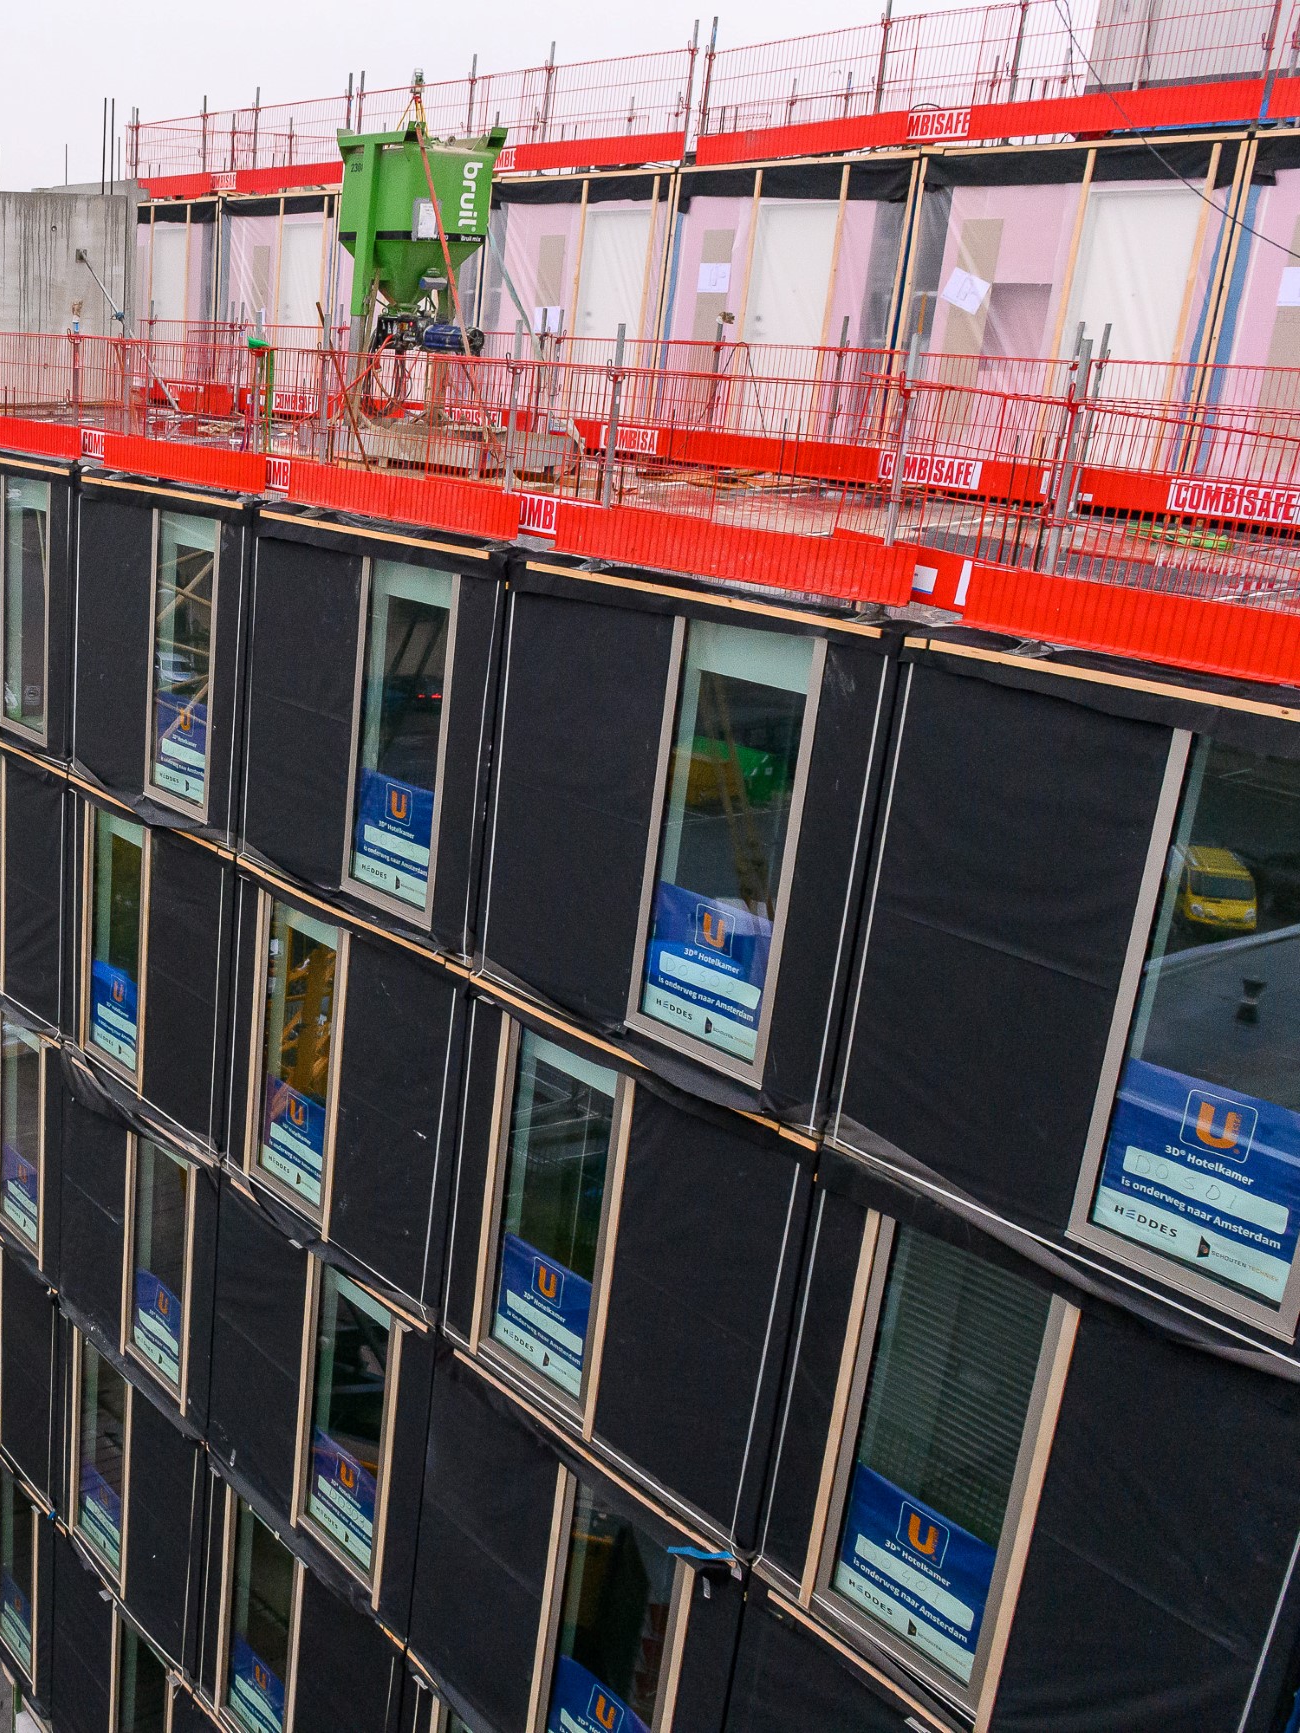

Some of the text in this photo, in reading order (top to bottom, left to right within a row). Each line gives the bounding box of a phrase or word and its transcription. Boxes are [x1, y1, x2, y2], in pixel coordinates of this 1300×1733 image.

[882, 453, 973, 487] CMBISAFE
[1174, 482, 1297, 521] COMBISAFE
[703, 912, 725, 948] U
[698, 950, 740, 975] Hotelkamer
[656, 998, 693, 1021] HEDDES
[665, 979, 698, 1000] onderweg
[698, 991, 715, 1005] naar
[715, 999, 754, 1023] Amsterdam
[1196, 1101, 1241, 1149] U
[1187, 1150, 1254, 1186] Hotelkamer
[1114, 1204, 1178, 1238] HEDDES
[1121, 1176, 1281, 1250] is onderweg naar Amsterdam
[538, 1265, 557, 1299] U
[503, 1327, 534, 1353] HEDDES
[908, 1513, 938, 1556] U
[901, 1549, 951, 1587] Hotelkamer
[848, 1578, 893, 1616] HEDDES
[853, 1557, 968, 1643] is onderweg naar Amsterdam
[595, 1694, 616, 1729] U
